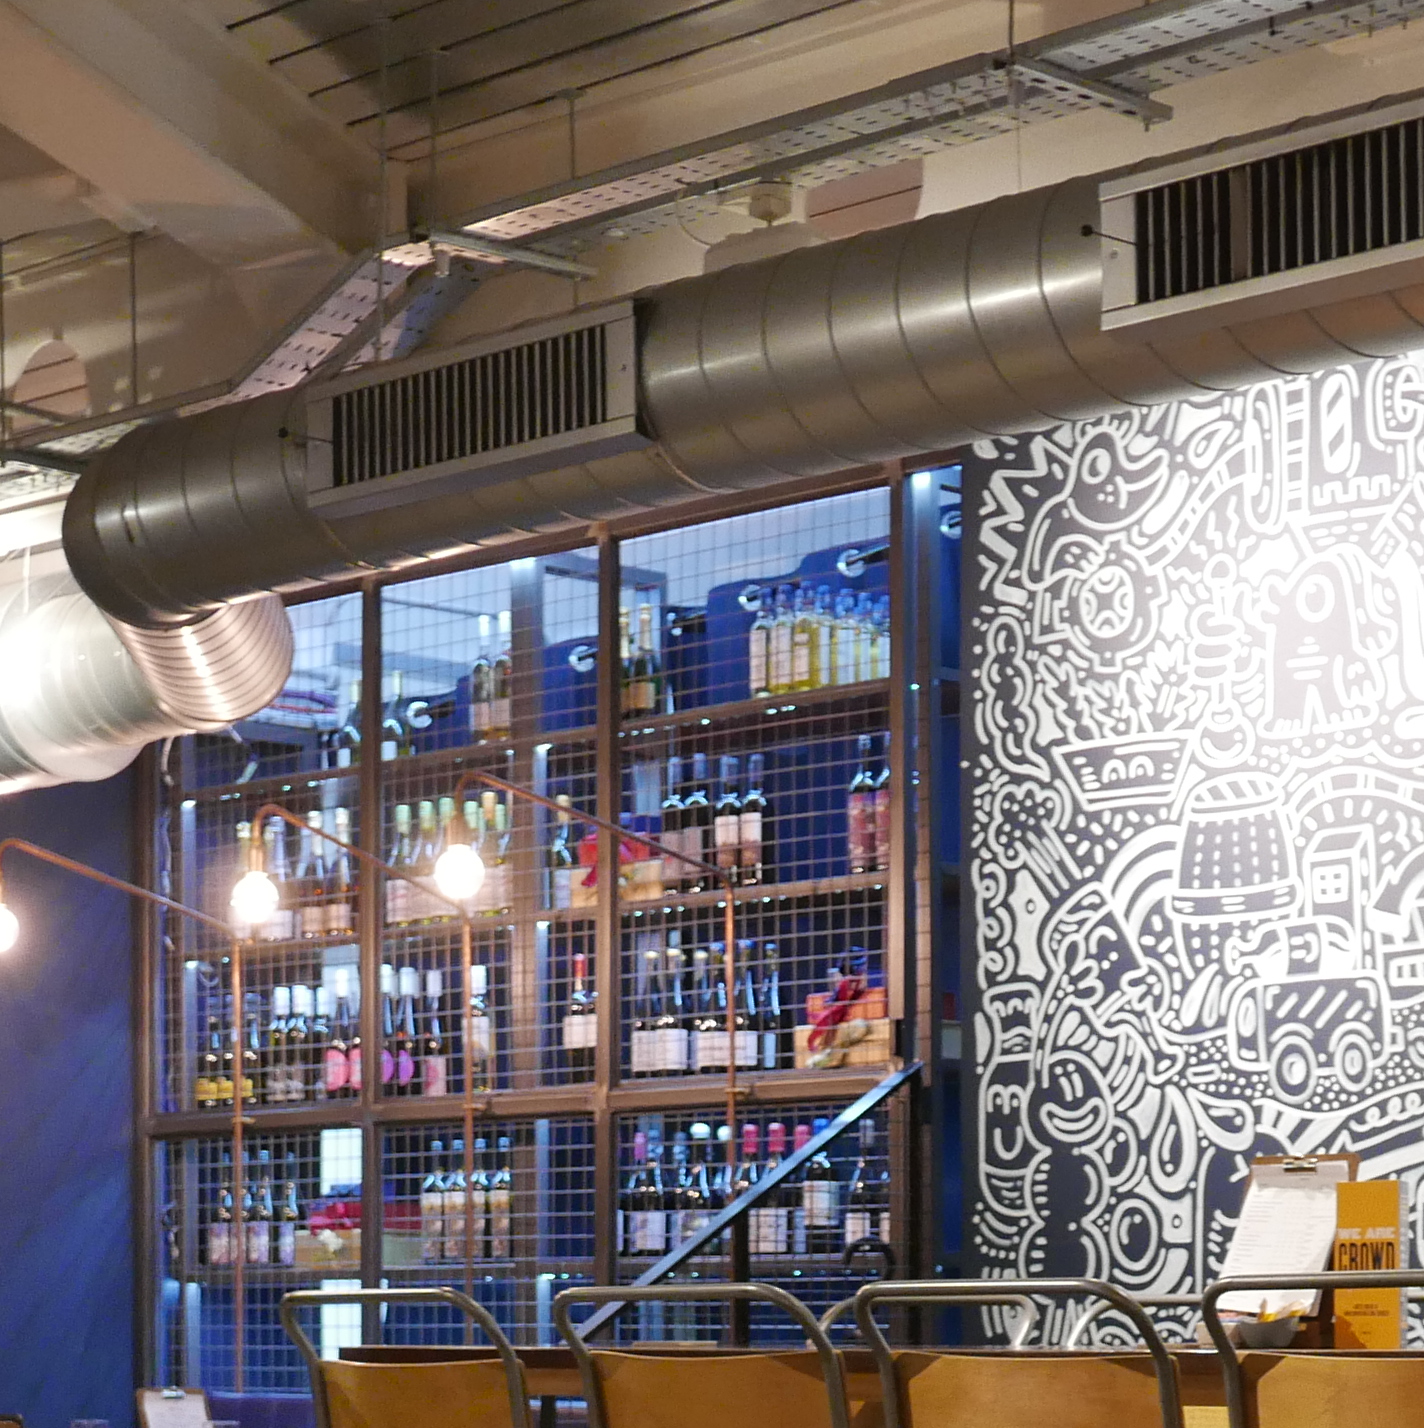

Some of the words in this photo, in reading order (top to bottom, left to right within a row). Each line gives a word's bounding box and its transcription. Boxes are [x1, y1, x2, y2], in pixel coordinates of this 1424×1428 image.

[1337, 1228, 1362, 1240] WE
[1365, 1227, 1396, 1239] ARE
[1339, 1241, 1395, 1271] CROWD
